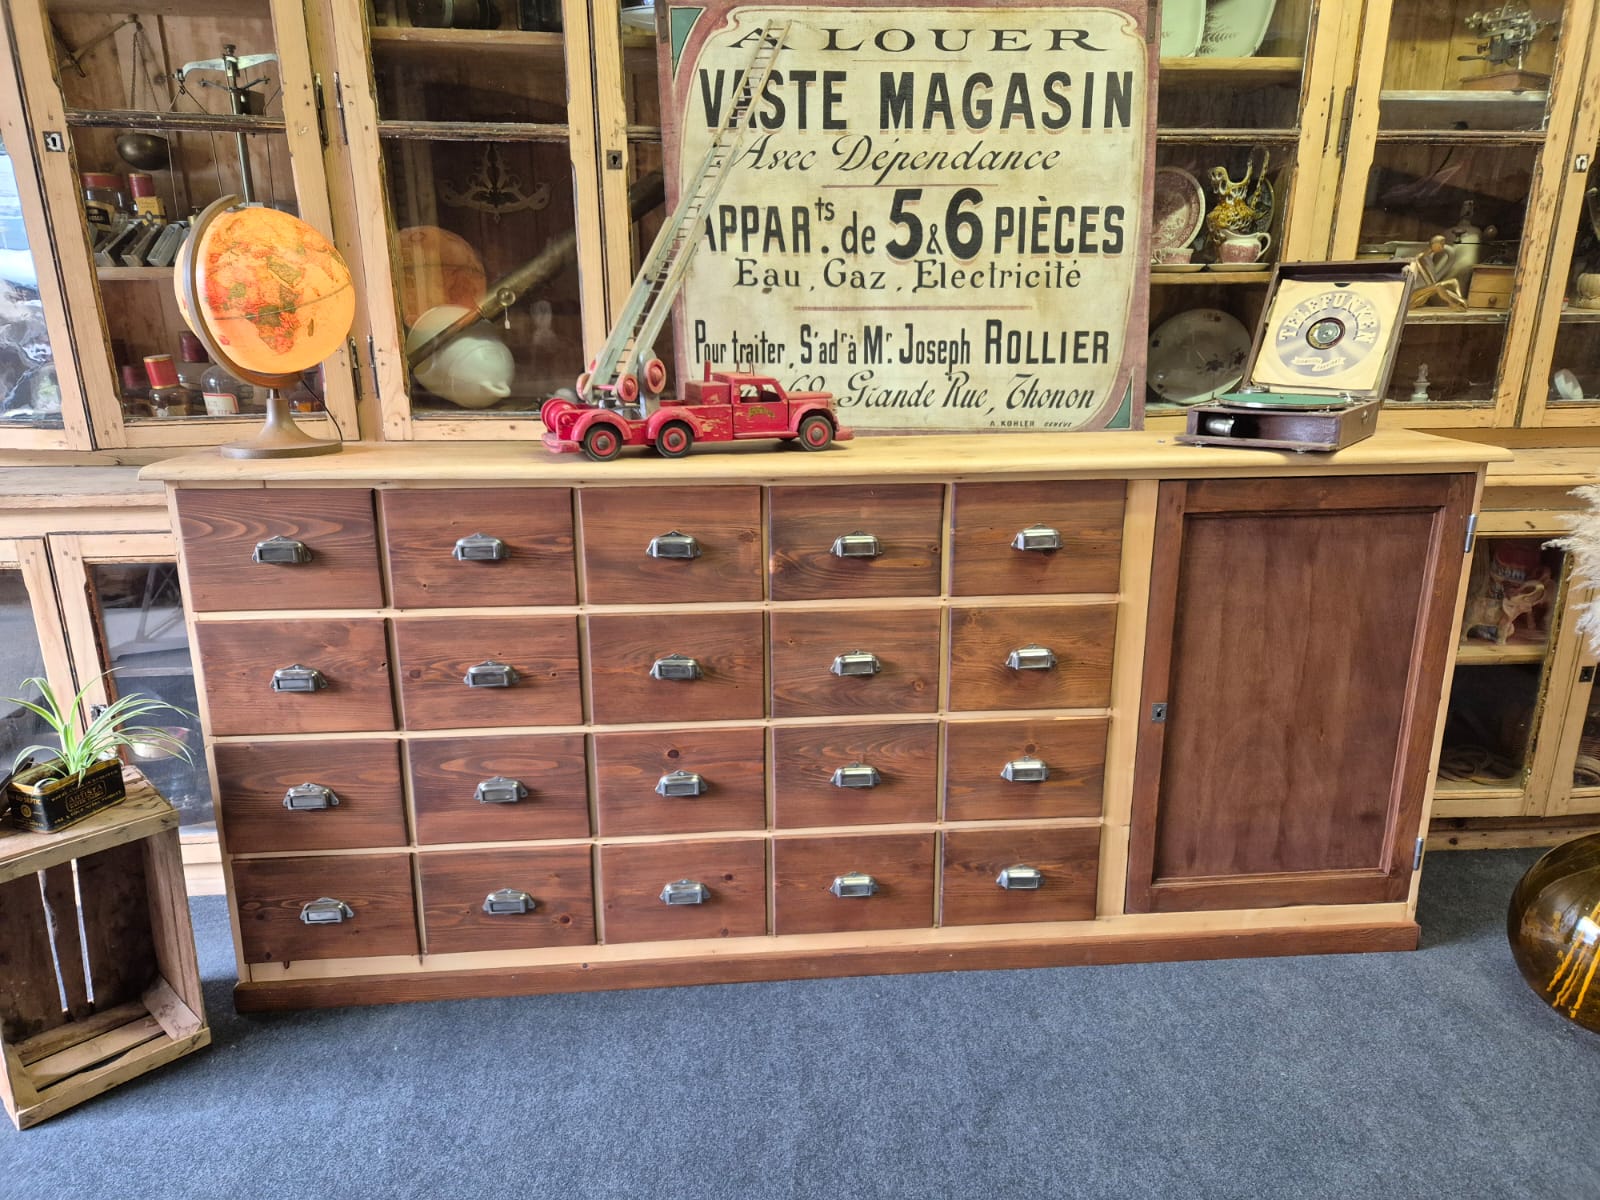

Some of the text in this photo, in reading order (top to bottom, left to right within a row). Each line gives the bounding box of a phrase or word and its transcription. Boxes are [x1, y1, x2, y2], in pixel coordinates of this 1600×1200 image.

[821, 28, 1108, 53] LOUER
[699, 67, 1133, 131] VASTE MAGASIN
[831, 135, 1061, 185] Dépendance
[841, 210, 876, 255] de
[994, 195, 1125, 254] PIÈCES
[911, 258, 1081, 292] Electricité
[1278, 291, 1377, 344] TELEFUNKEN
[694, 319, 727, 366] Pour
[899, 323, 971, 379] Joseph
[985, 319, 1109, 365] ROLLIER
[835, 369, 934, 409] Grande
[1004, 372, 1096, 409] Thonon
